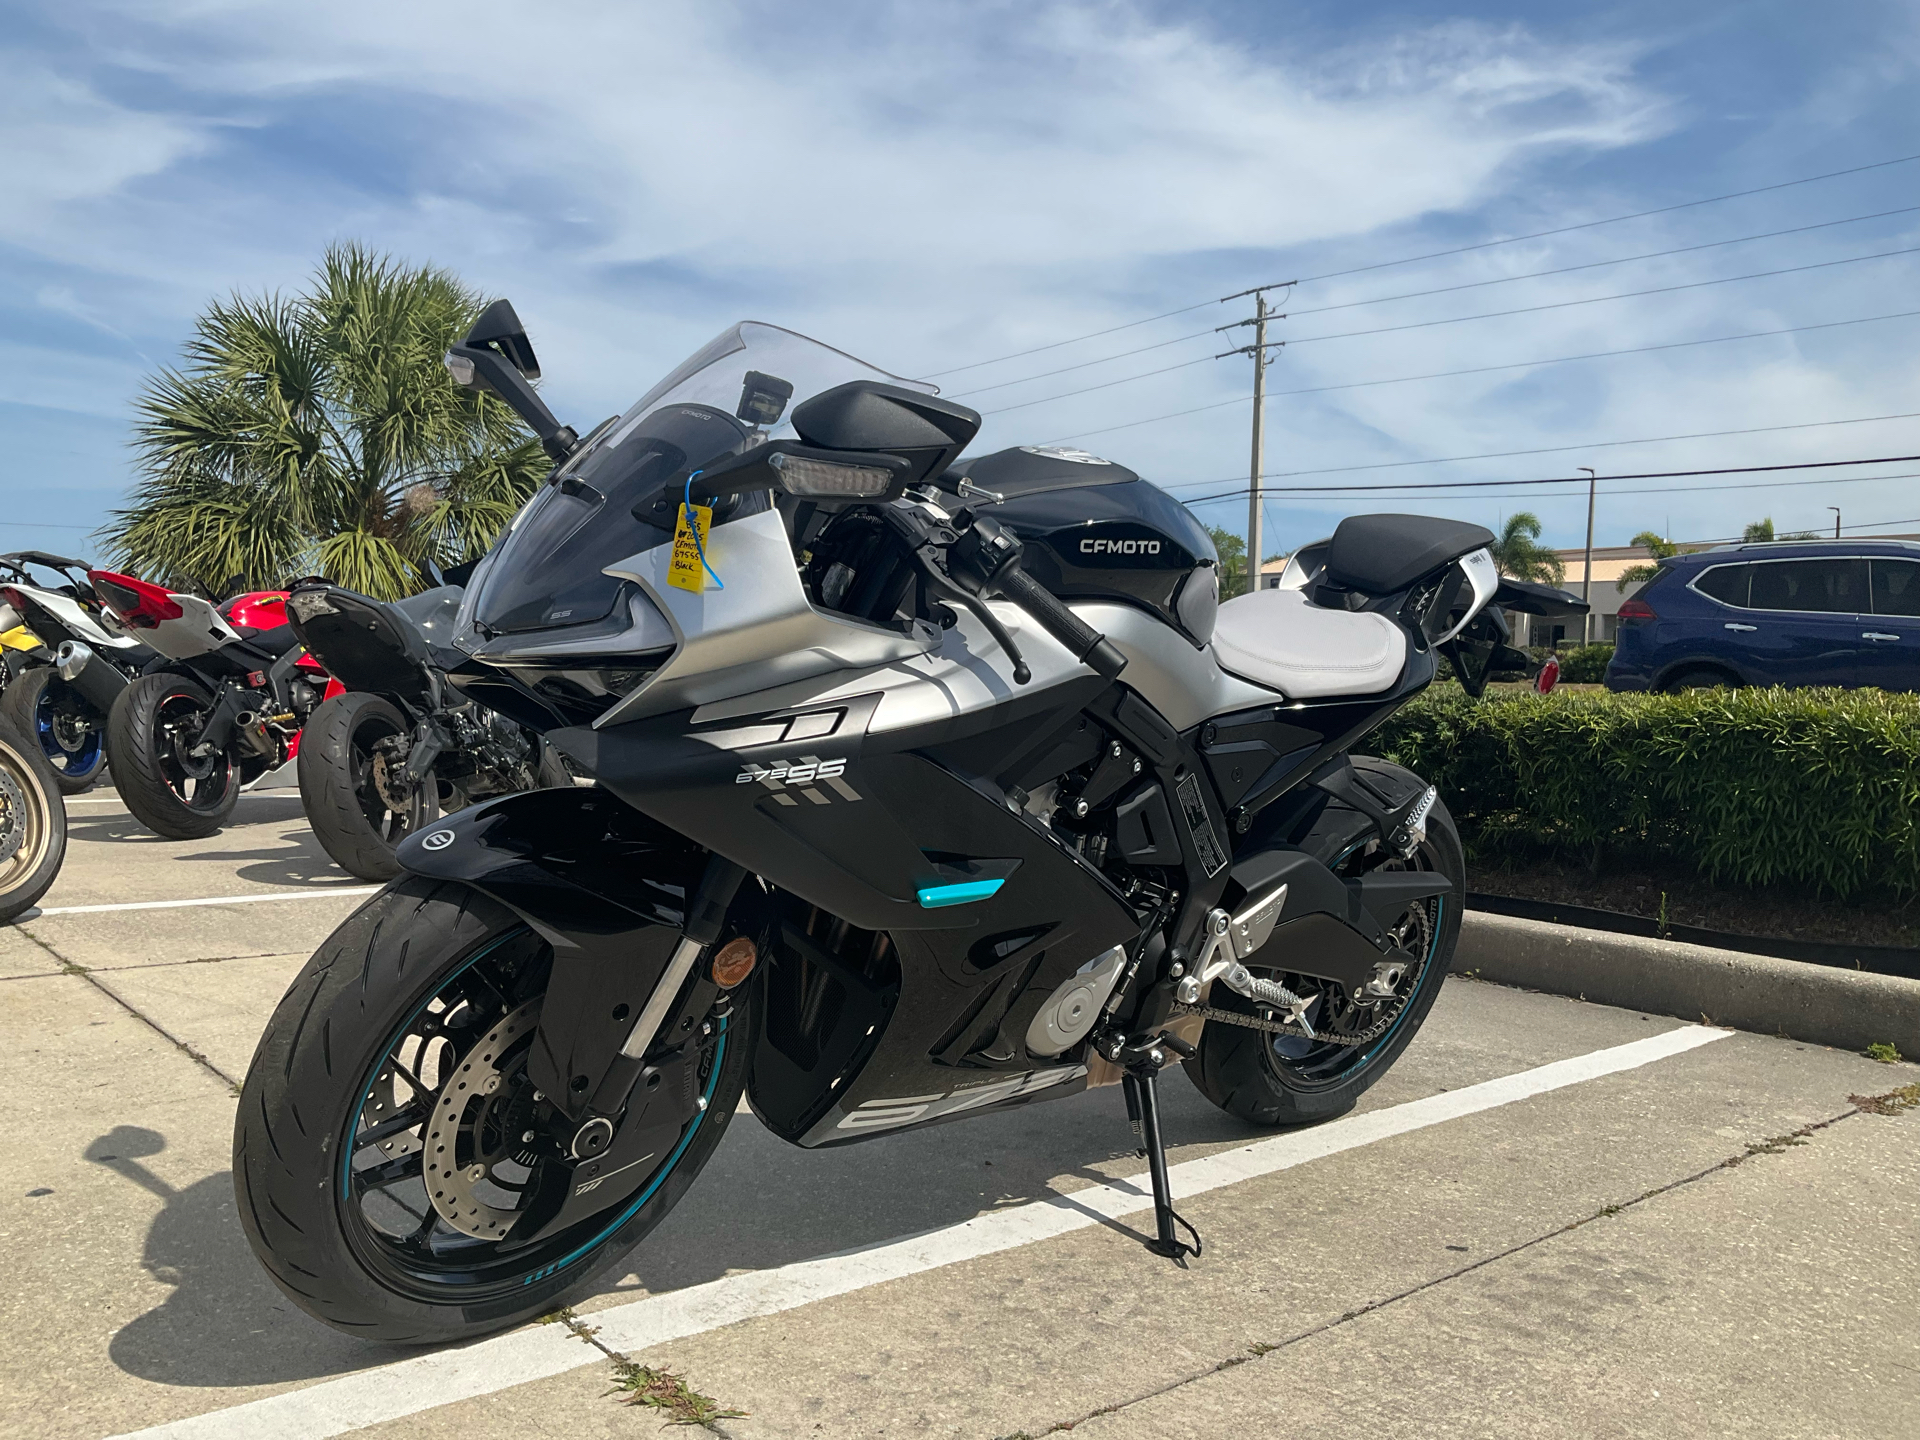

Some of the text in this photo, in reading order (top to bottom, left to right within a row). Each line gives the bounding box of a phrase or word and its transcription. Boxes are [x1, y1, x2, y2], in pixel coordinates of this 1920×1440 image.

[686, 531, 705, 541] 205
[1080, 539, 1160, 554] CFMOTO
[735, 758, 847, 784] 675SS
